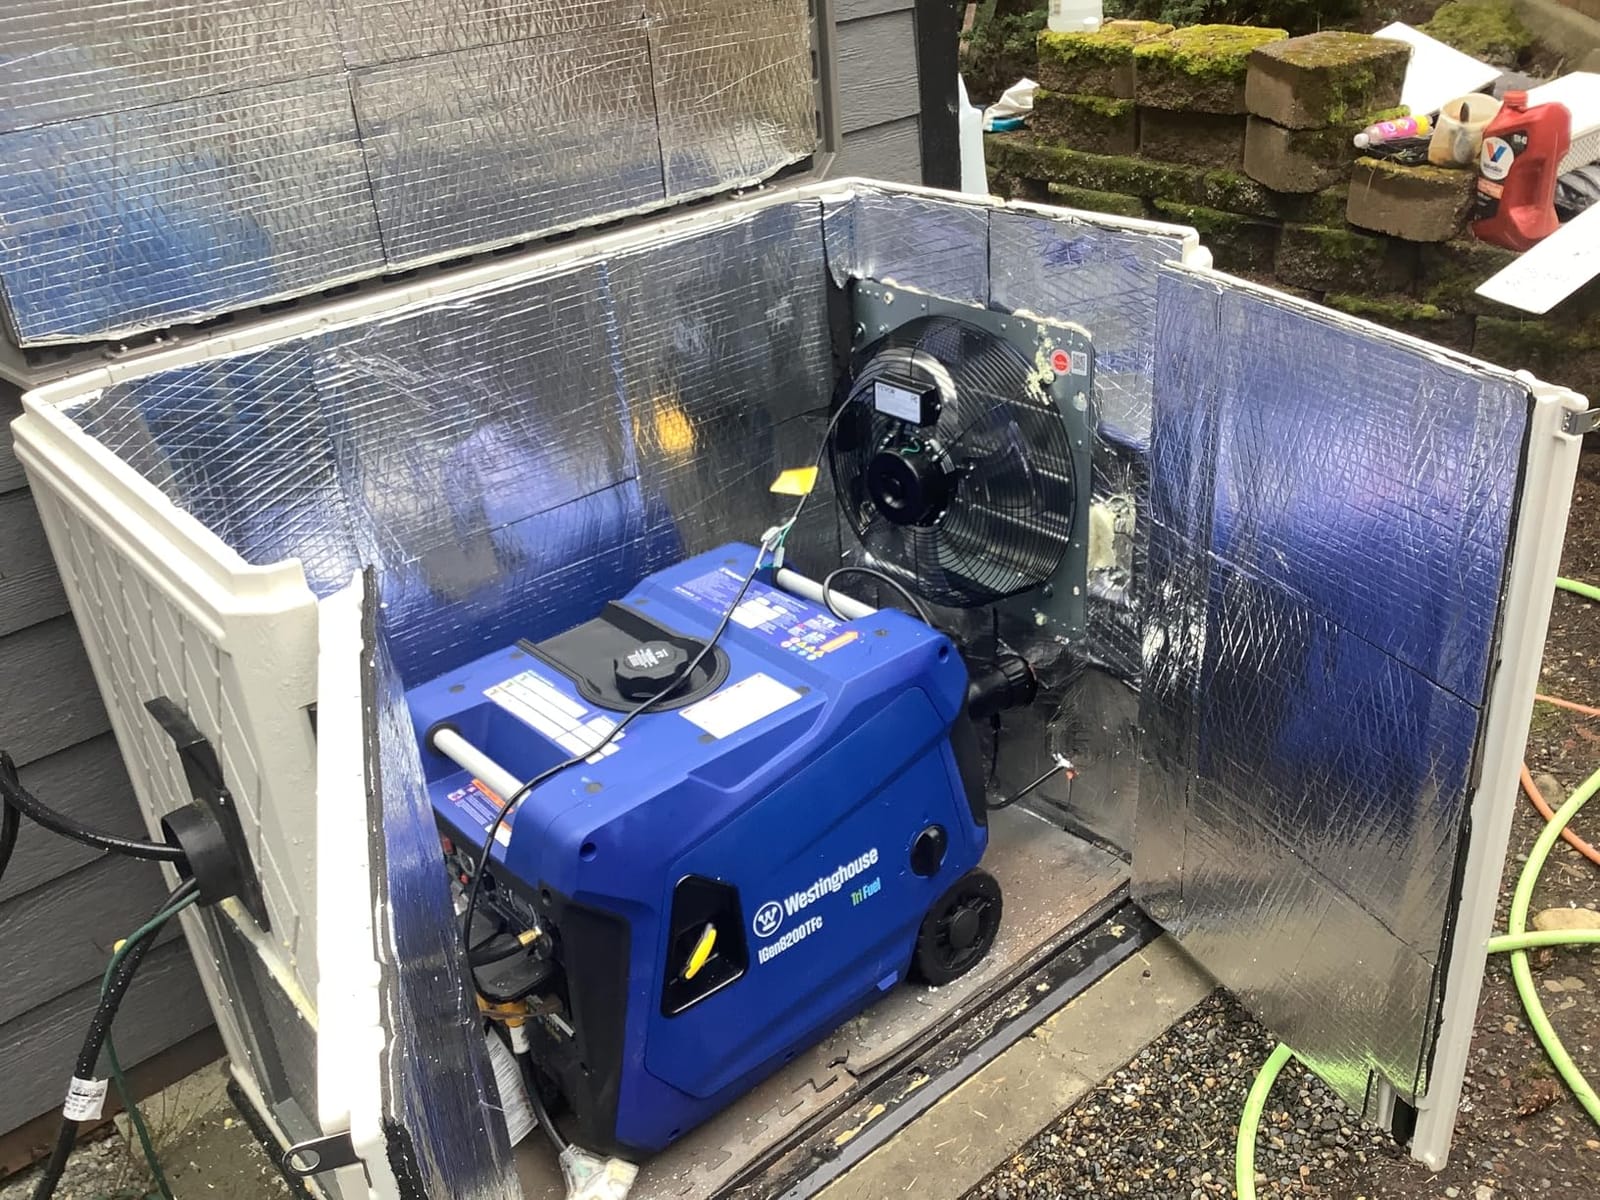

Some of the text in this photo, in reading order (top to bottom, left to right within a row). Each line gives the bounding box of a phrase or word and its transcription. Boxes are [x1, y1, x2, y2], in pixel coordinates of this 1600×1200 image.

[785, 848, 878, 916] Westinghouse
[851, 877, 881, 907] Tri Fuel
